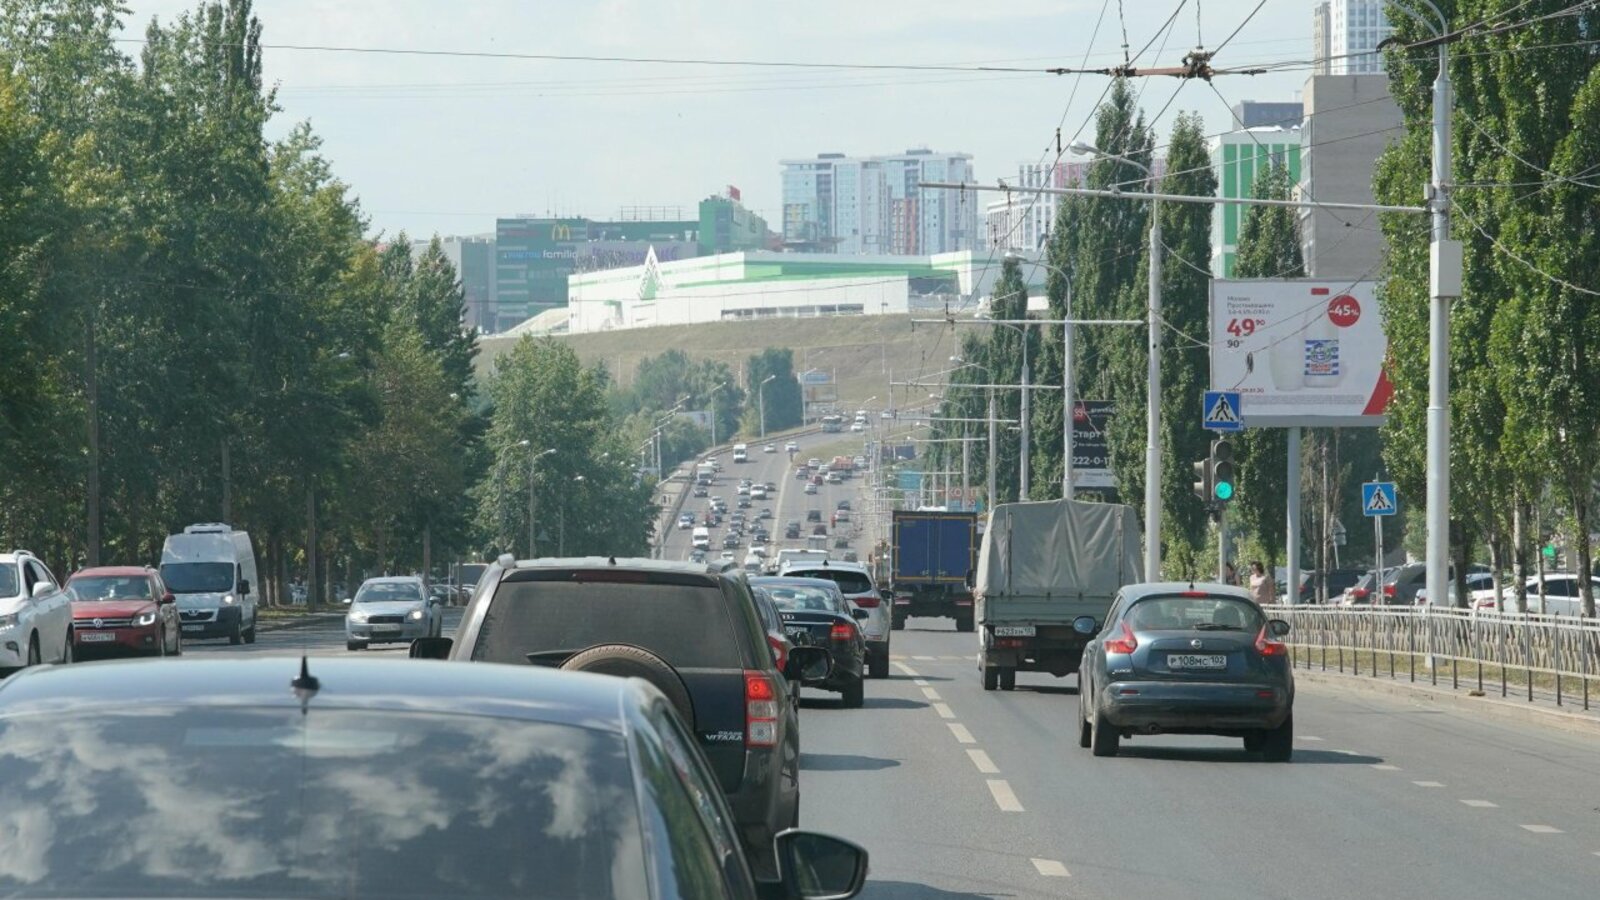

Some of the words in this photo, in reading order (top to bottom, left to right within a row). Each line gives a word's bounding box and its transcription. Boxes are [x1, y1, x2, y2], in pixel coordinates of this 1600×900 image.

[1227, 318, 1255, 337] 49
[1227, 339, 1240, 348] 90
[1210, 655, 1225, 664] 102
